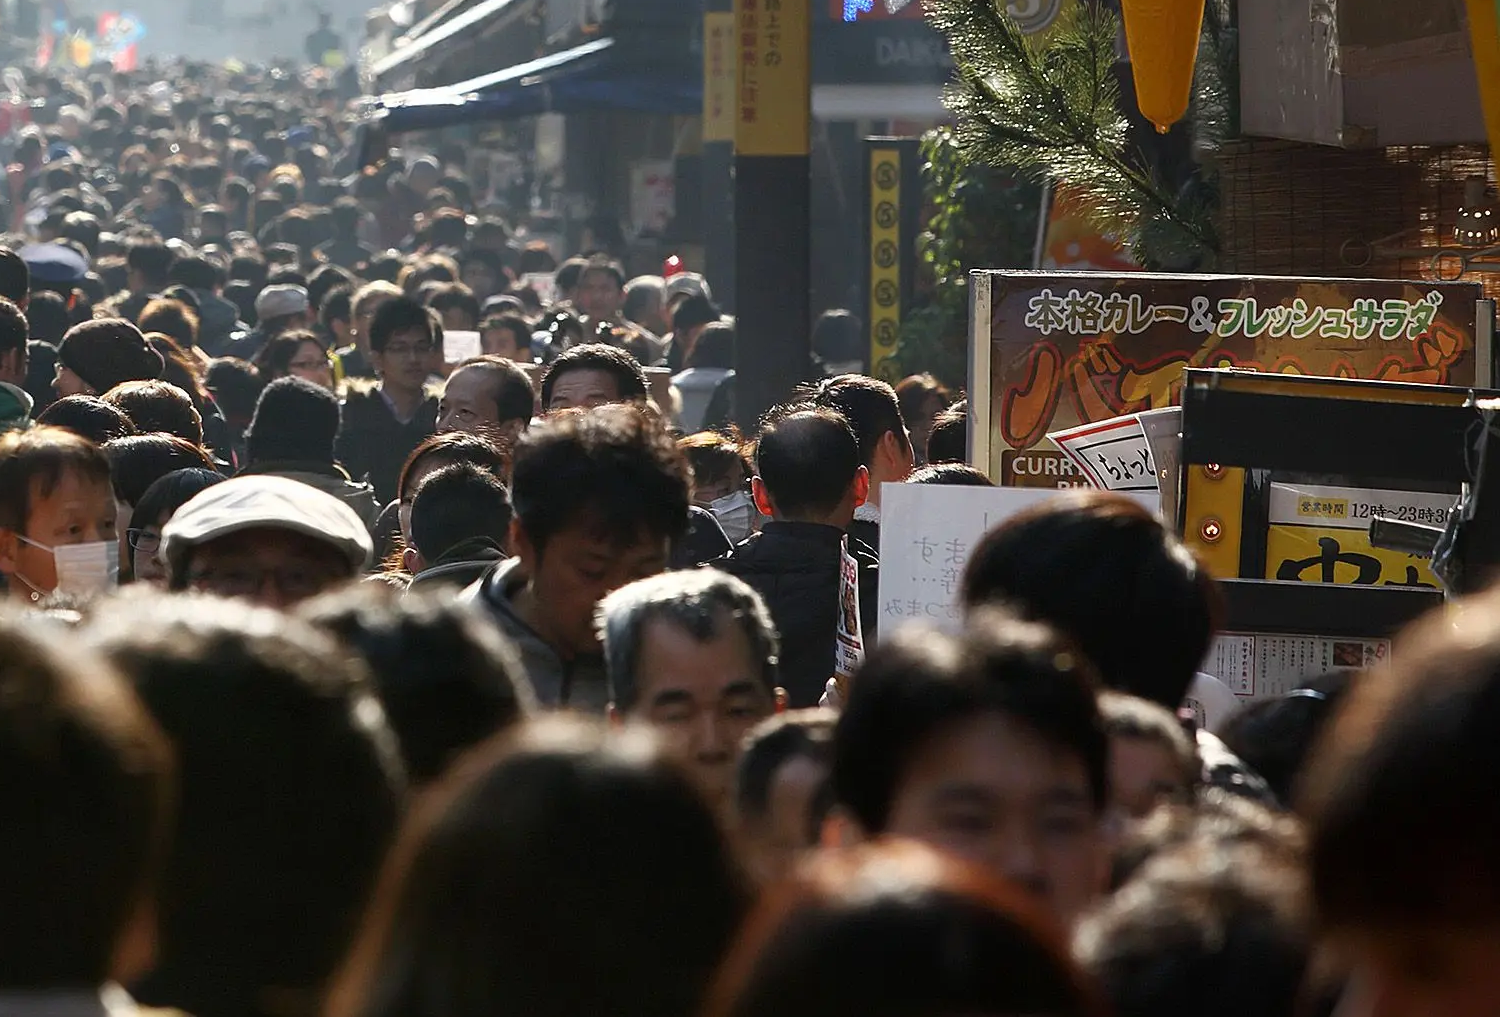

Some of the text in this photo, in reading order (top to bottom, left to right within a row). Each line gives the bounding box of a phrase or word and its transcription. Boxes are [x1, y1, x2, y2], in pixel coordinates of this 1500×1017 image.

[1024, 288, 1444, 341] 本格カレー&フレッシュサラダ
[1012, 456, 1083, 476] CURR
[1301, 500, 1448, 524] 営業時間 12時〜23時3
